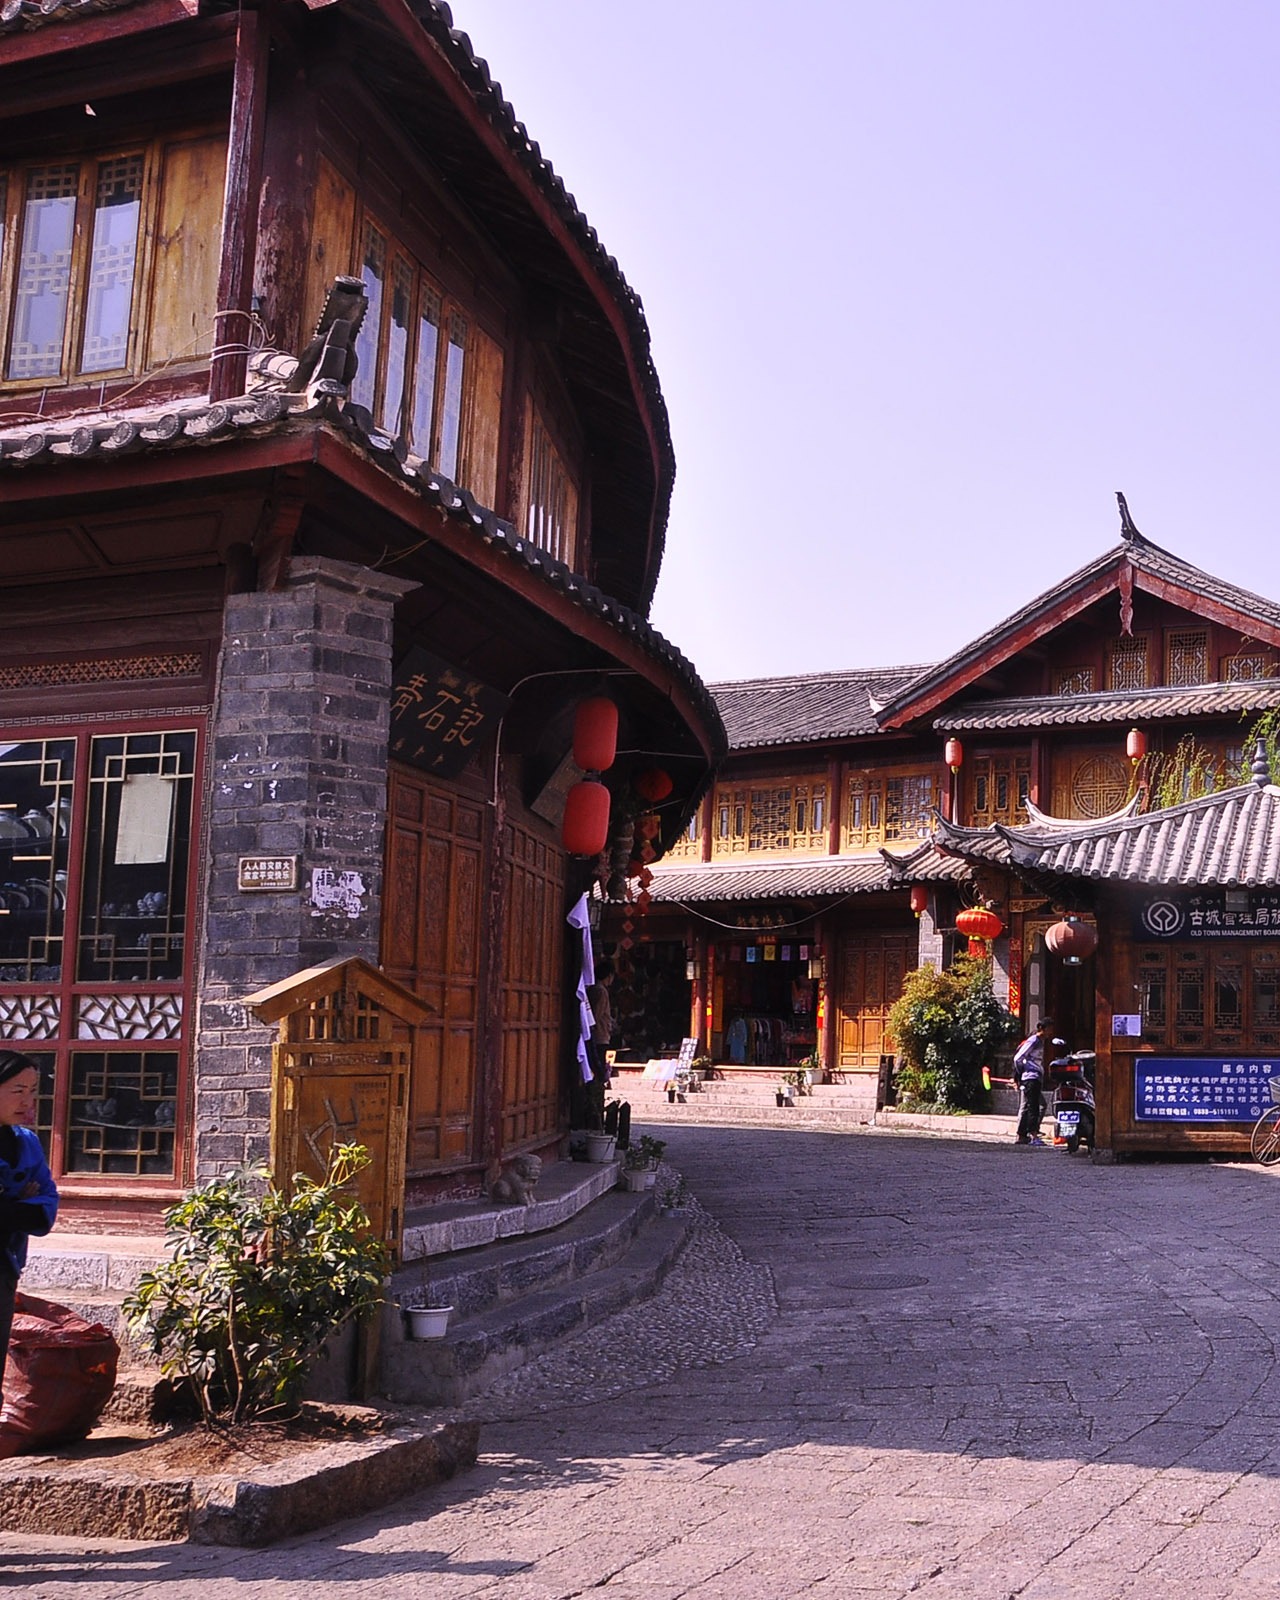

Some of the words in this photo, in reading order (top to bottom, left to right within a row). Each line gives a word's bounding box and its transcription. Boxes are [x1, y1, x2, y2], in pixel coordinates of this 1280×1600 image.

[1190, 929, 1202, 937] OLD
[1203, 929, 1220, 937] TOWN
[1222, 1064, 1272, 1074] 服务内容
